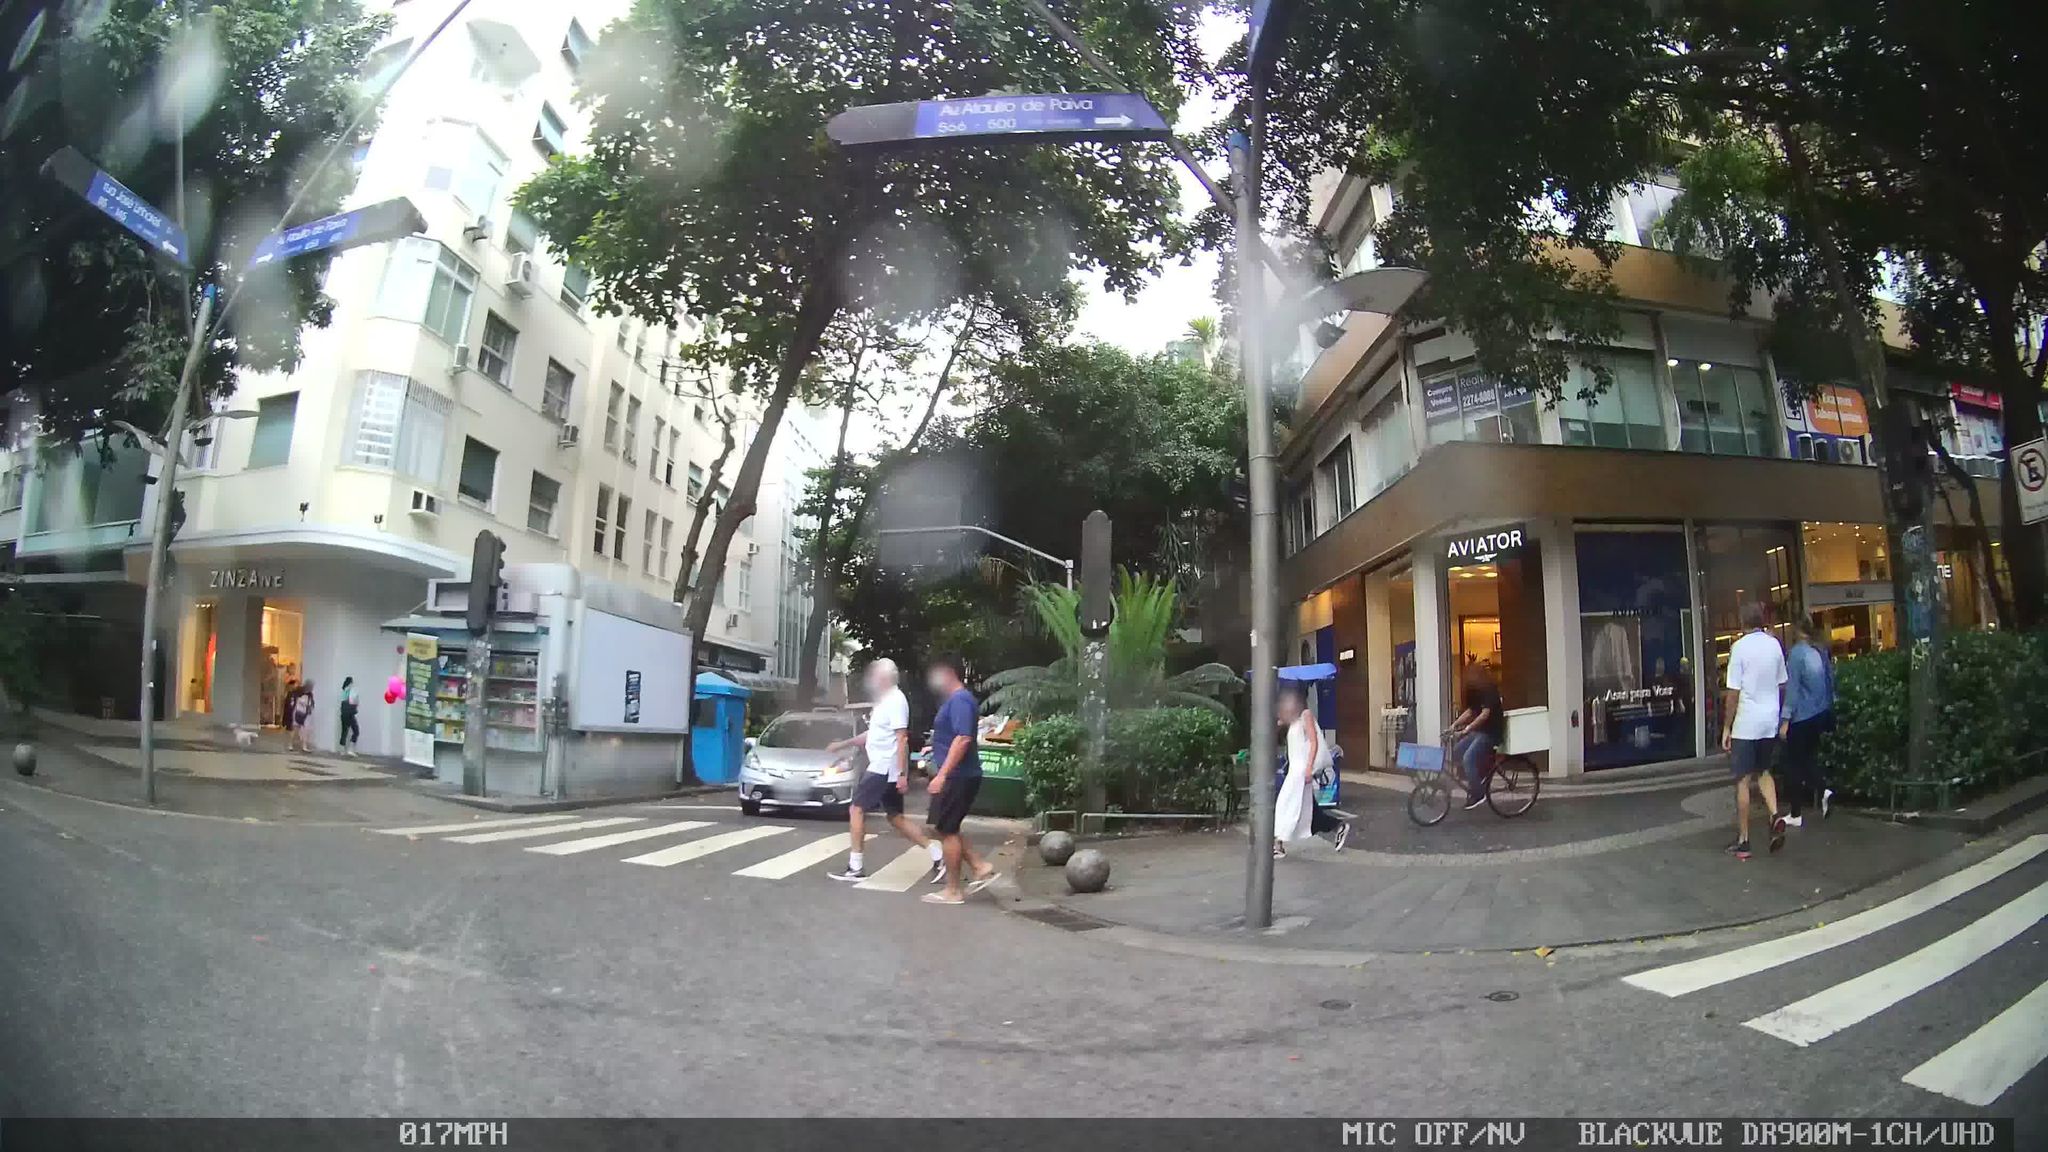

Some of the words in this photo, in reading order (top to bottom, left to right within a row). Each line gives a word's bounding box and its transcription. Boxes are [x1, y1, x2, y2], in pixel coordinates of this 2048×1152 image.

[1022, 99, 1045, 112] de
[1050, 98, 1093, 111] Paiva
[1447, 530, 1523, 559] AVIATOR
